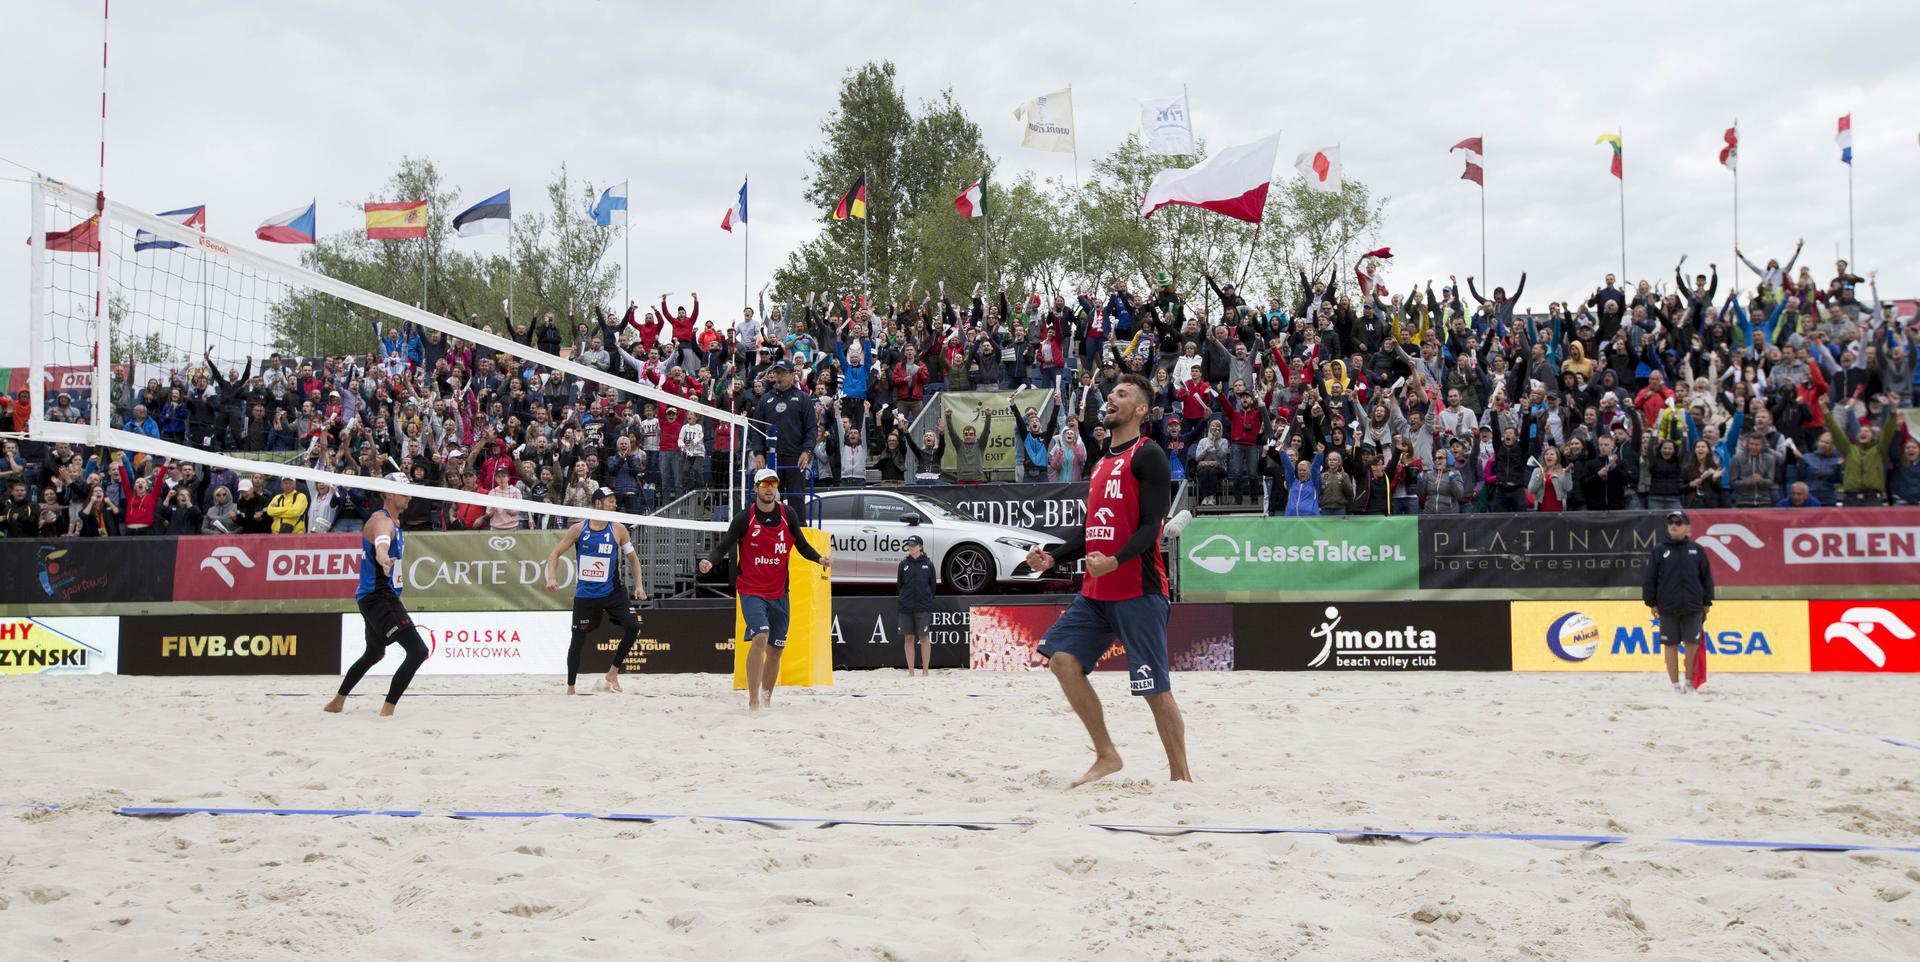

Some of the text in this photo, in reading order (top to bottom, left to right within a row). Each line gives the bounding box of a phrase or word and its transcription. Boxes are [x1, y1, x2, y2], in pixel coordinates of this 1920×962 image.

[985, 453, 1006, 461] EXIT
[1111, 458, 1125, 476] 2
[1104, 479, 1124, 499] POL
[604, 532, 610, 542] 1
[778, 530, 784, 541] 1
[598, 543, 613, 554] NED
[774, 542, 787, 554] POL
[1245, 540, 1406, 563] LeaseTake.PL
[1792, 533, 1915, 558] ORLEN
[273, 554, 361, 576] ORLEN
[409, 556, 577, 590] CARTE D'O
[445, 630, 521, 642] POLSKA
[868, 614, 890, 644] A
[1336, 625, 1437, 649] monta
[162, 635, 297, 657] FIVB.COM
[445, 645, 521, 658] SIATKÓWKA
[640, 643, 671, 651] TOUR
[1337, 655, 1437, 669] beach volley club
